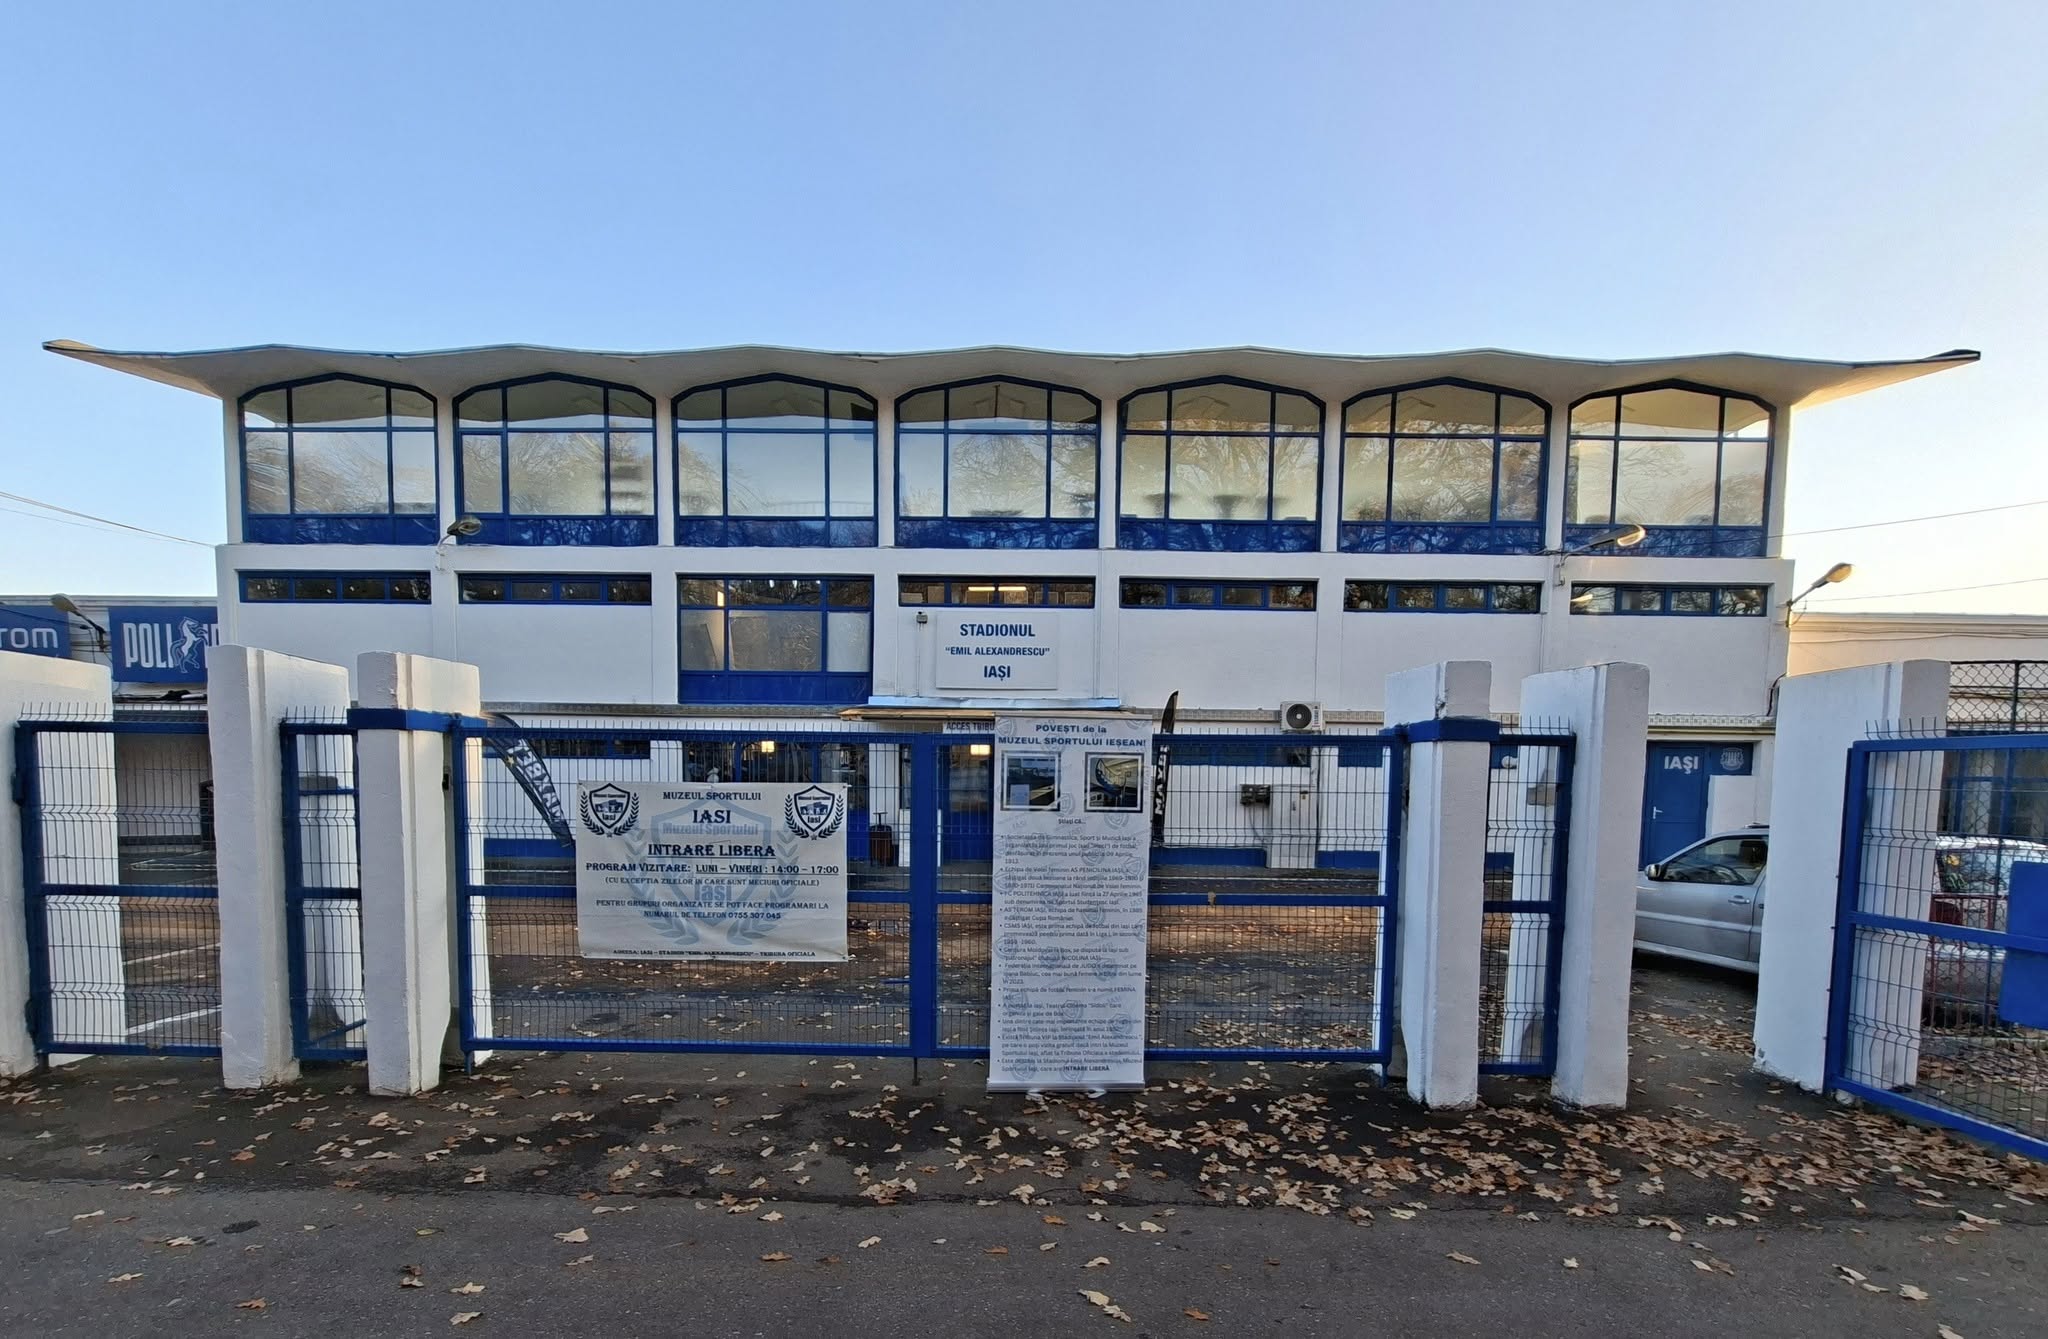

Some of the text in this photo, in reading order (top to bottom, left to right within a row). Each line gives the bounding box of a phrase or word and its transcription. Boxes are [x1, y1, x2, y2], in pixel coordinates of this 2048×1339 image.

[960, 623, 1036, 637] STADIONUL
[122, 623, 174, 668] POLI
[984, 665, 1011, 681] IAȘI
[946, 721, 970, 730] ACCES
[1035, 724, 1107, 735] POVEȘTI de la
[998, 736, 1041, 745] MUZEUL
[1044, 737, 1103, 746] SPORTULUI
[663, 791, 762, 800] MUZEUL SPORTULUI
[693, 809, 731, 823] IASI
[648, 844, 776, 856] INTRARE LIBERA
[586, 863, 636, 872] PROGRAM
[639, 863, 691, 872] VIZITARE:
[696, 864, 718, 873] LUNI
[729, 864, 762, 873] VINERI
[605, 876, 619, 884] (CU
[661, 877, 693, 885] ZILELOR
[726, 901, 743, 909] POT
[744, 901, 763, 909] FACE
